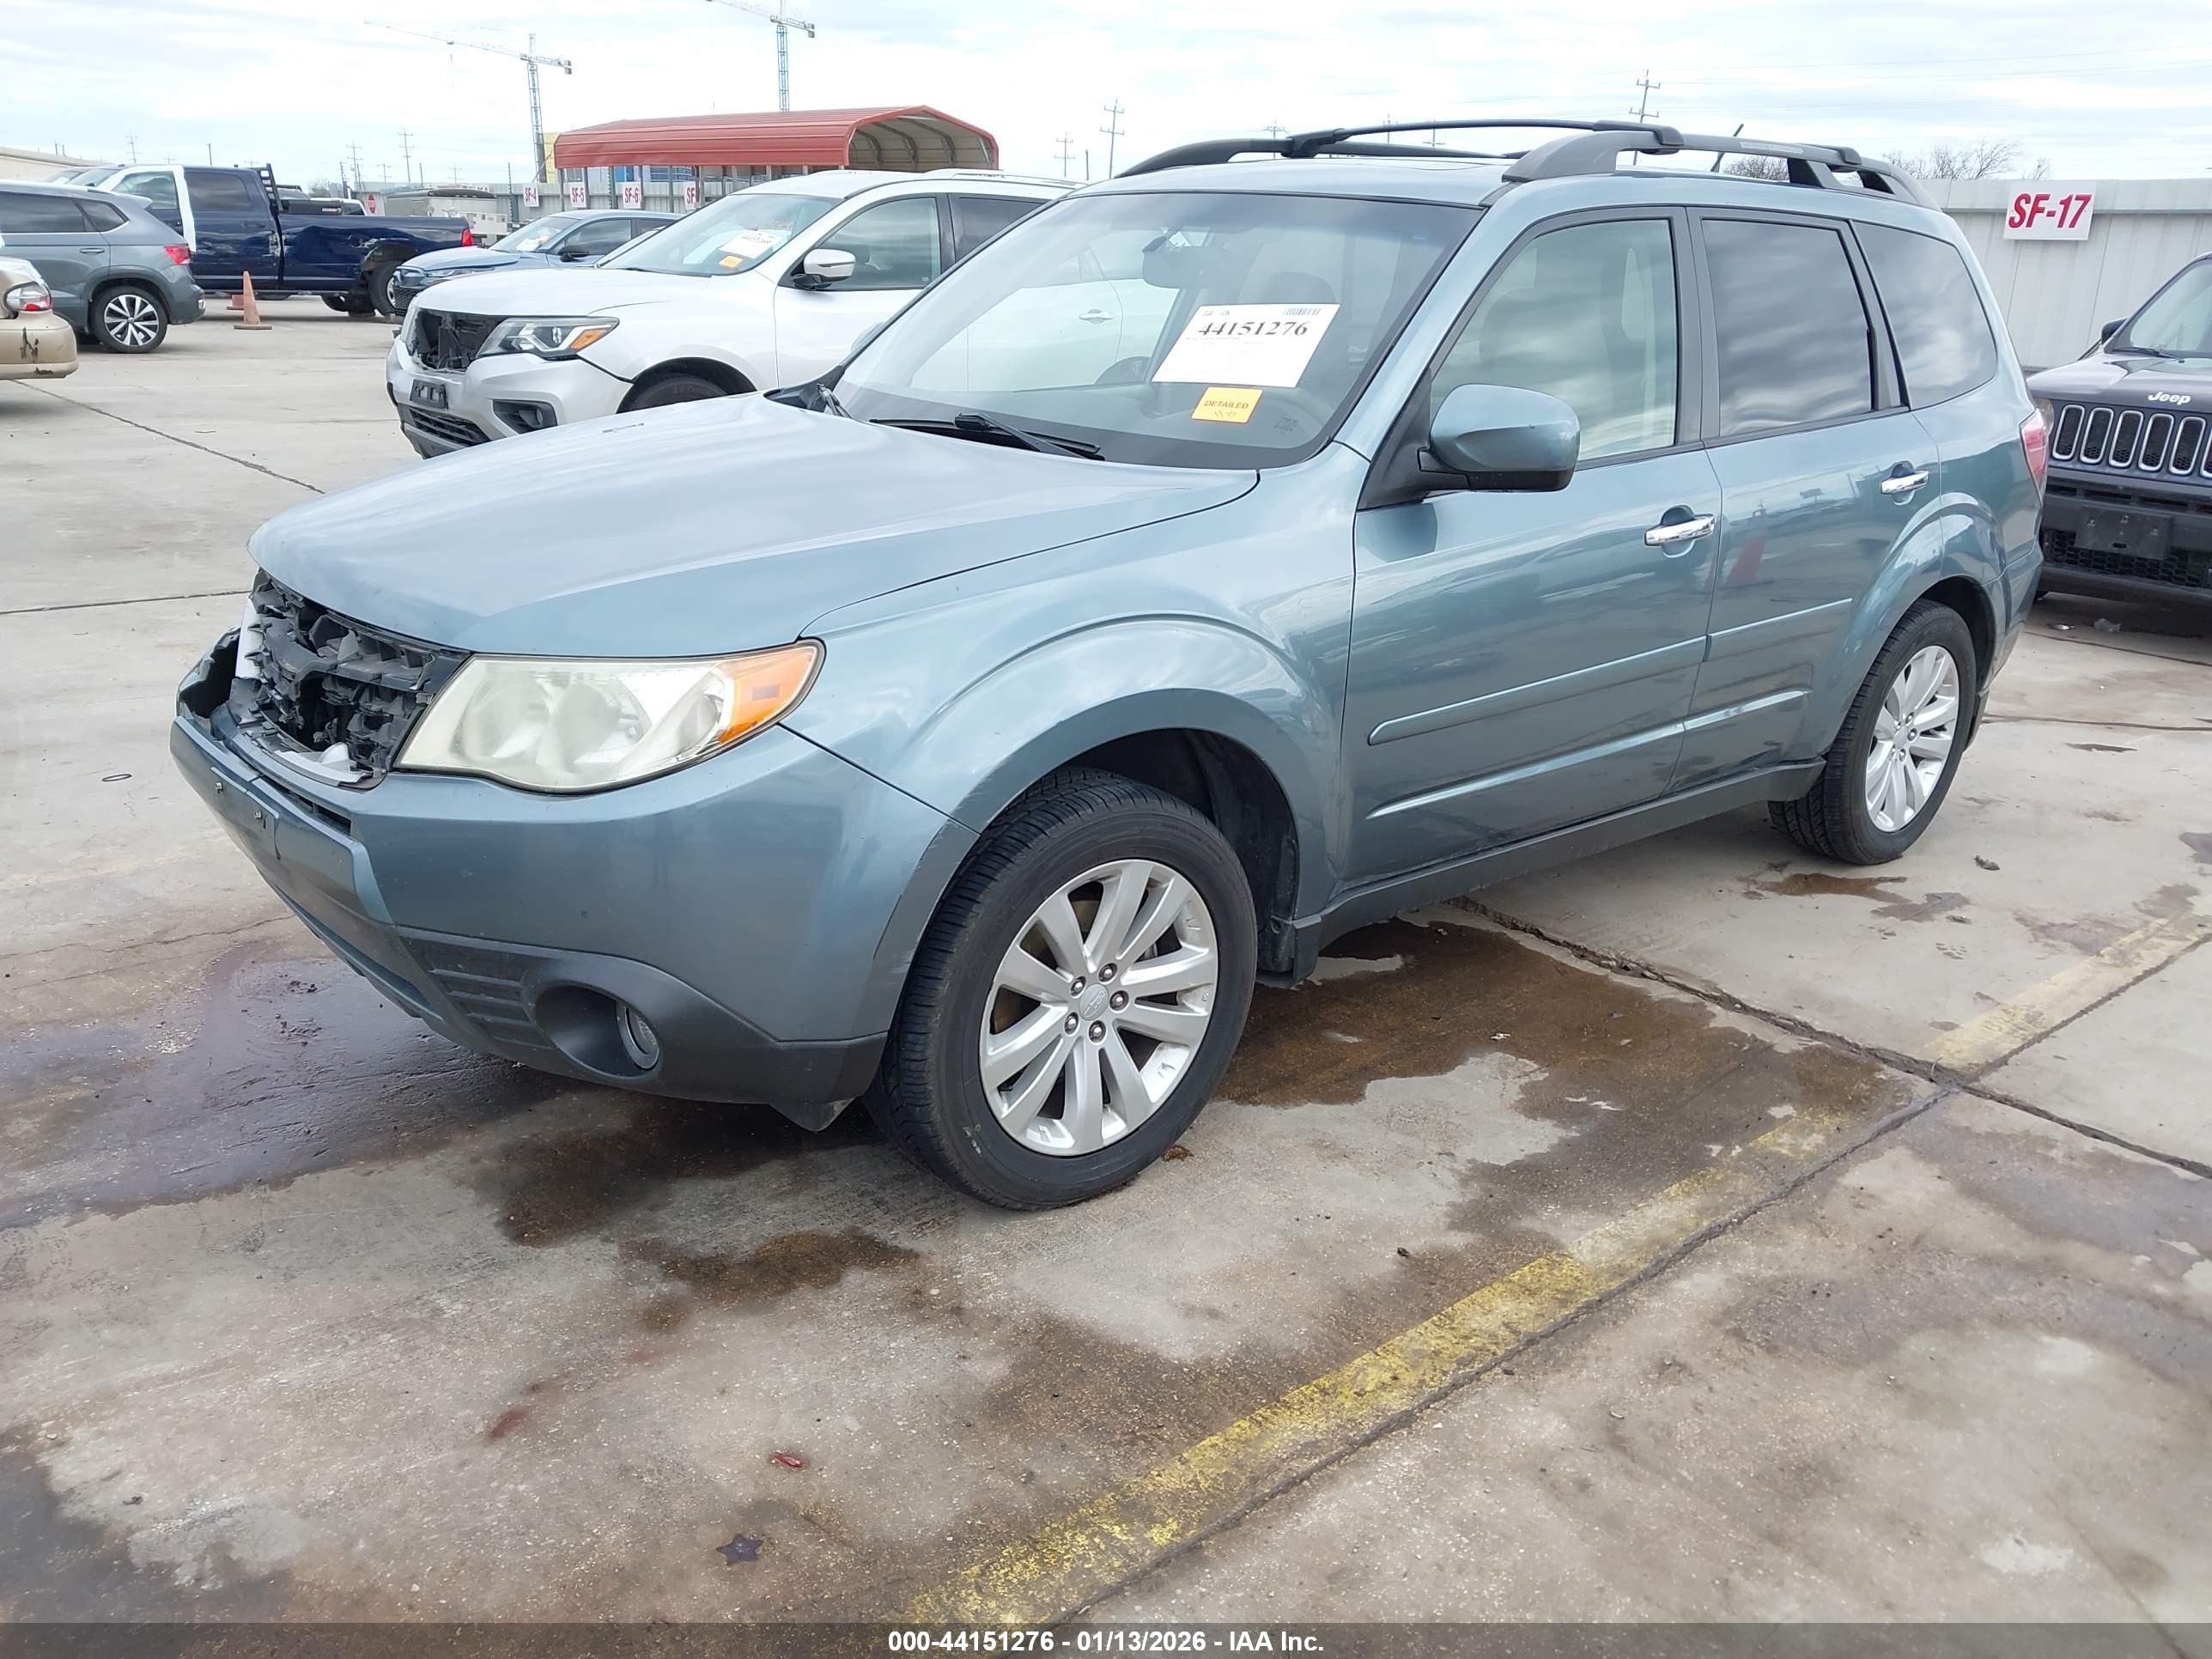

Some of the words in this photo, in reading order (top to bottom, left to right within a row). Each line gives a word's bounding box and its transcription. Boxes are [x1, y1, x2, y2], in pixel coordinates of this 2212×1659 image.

[571, 186, 584, 203] SF-5
[624, 186, 639, 203] SF-6
[2008, 193, 2093, 228] SF-17
[1198, 321, 1310, 336] 44151276
[1204, 399, 1249, 410] DETAILED
[2148, 391, 2191, 405] Jeep
